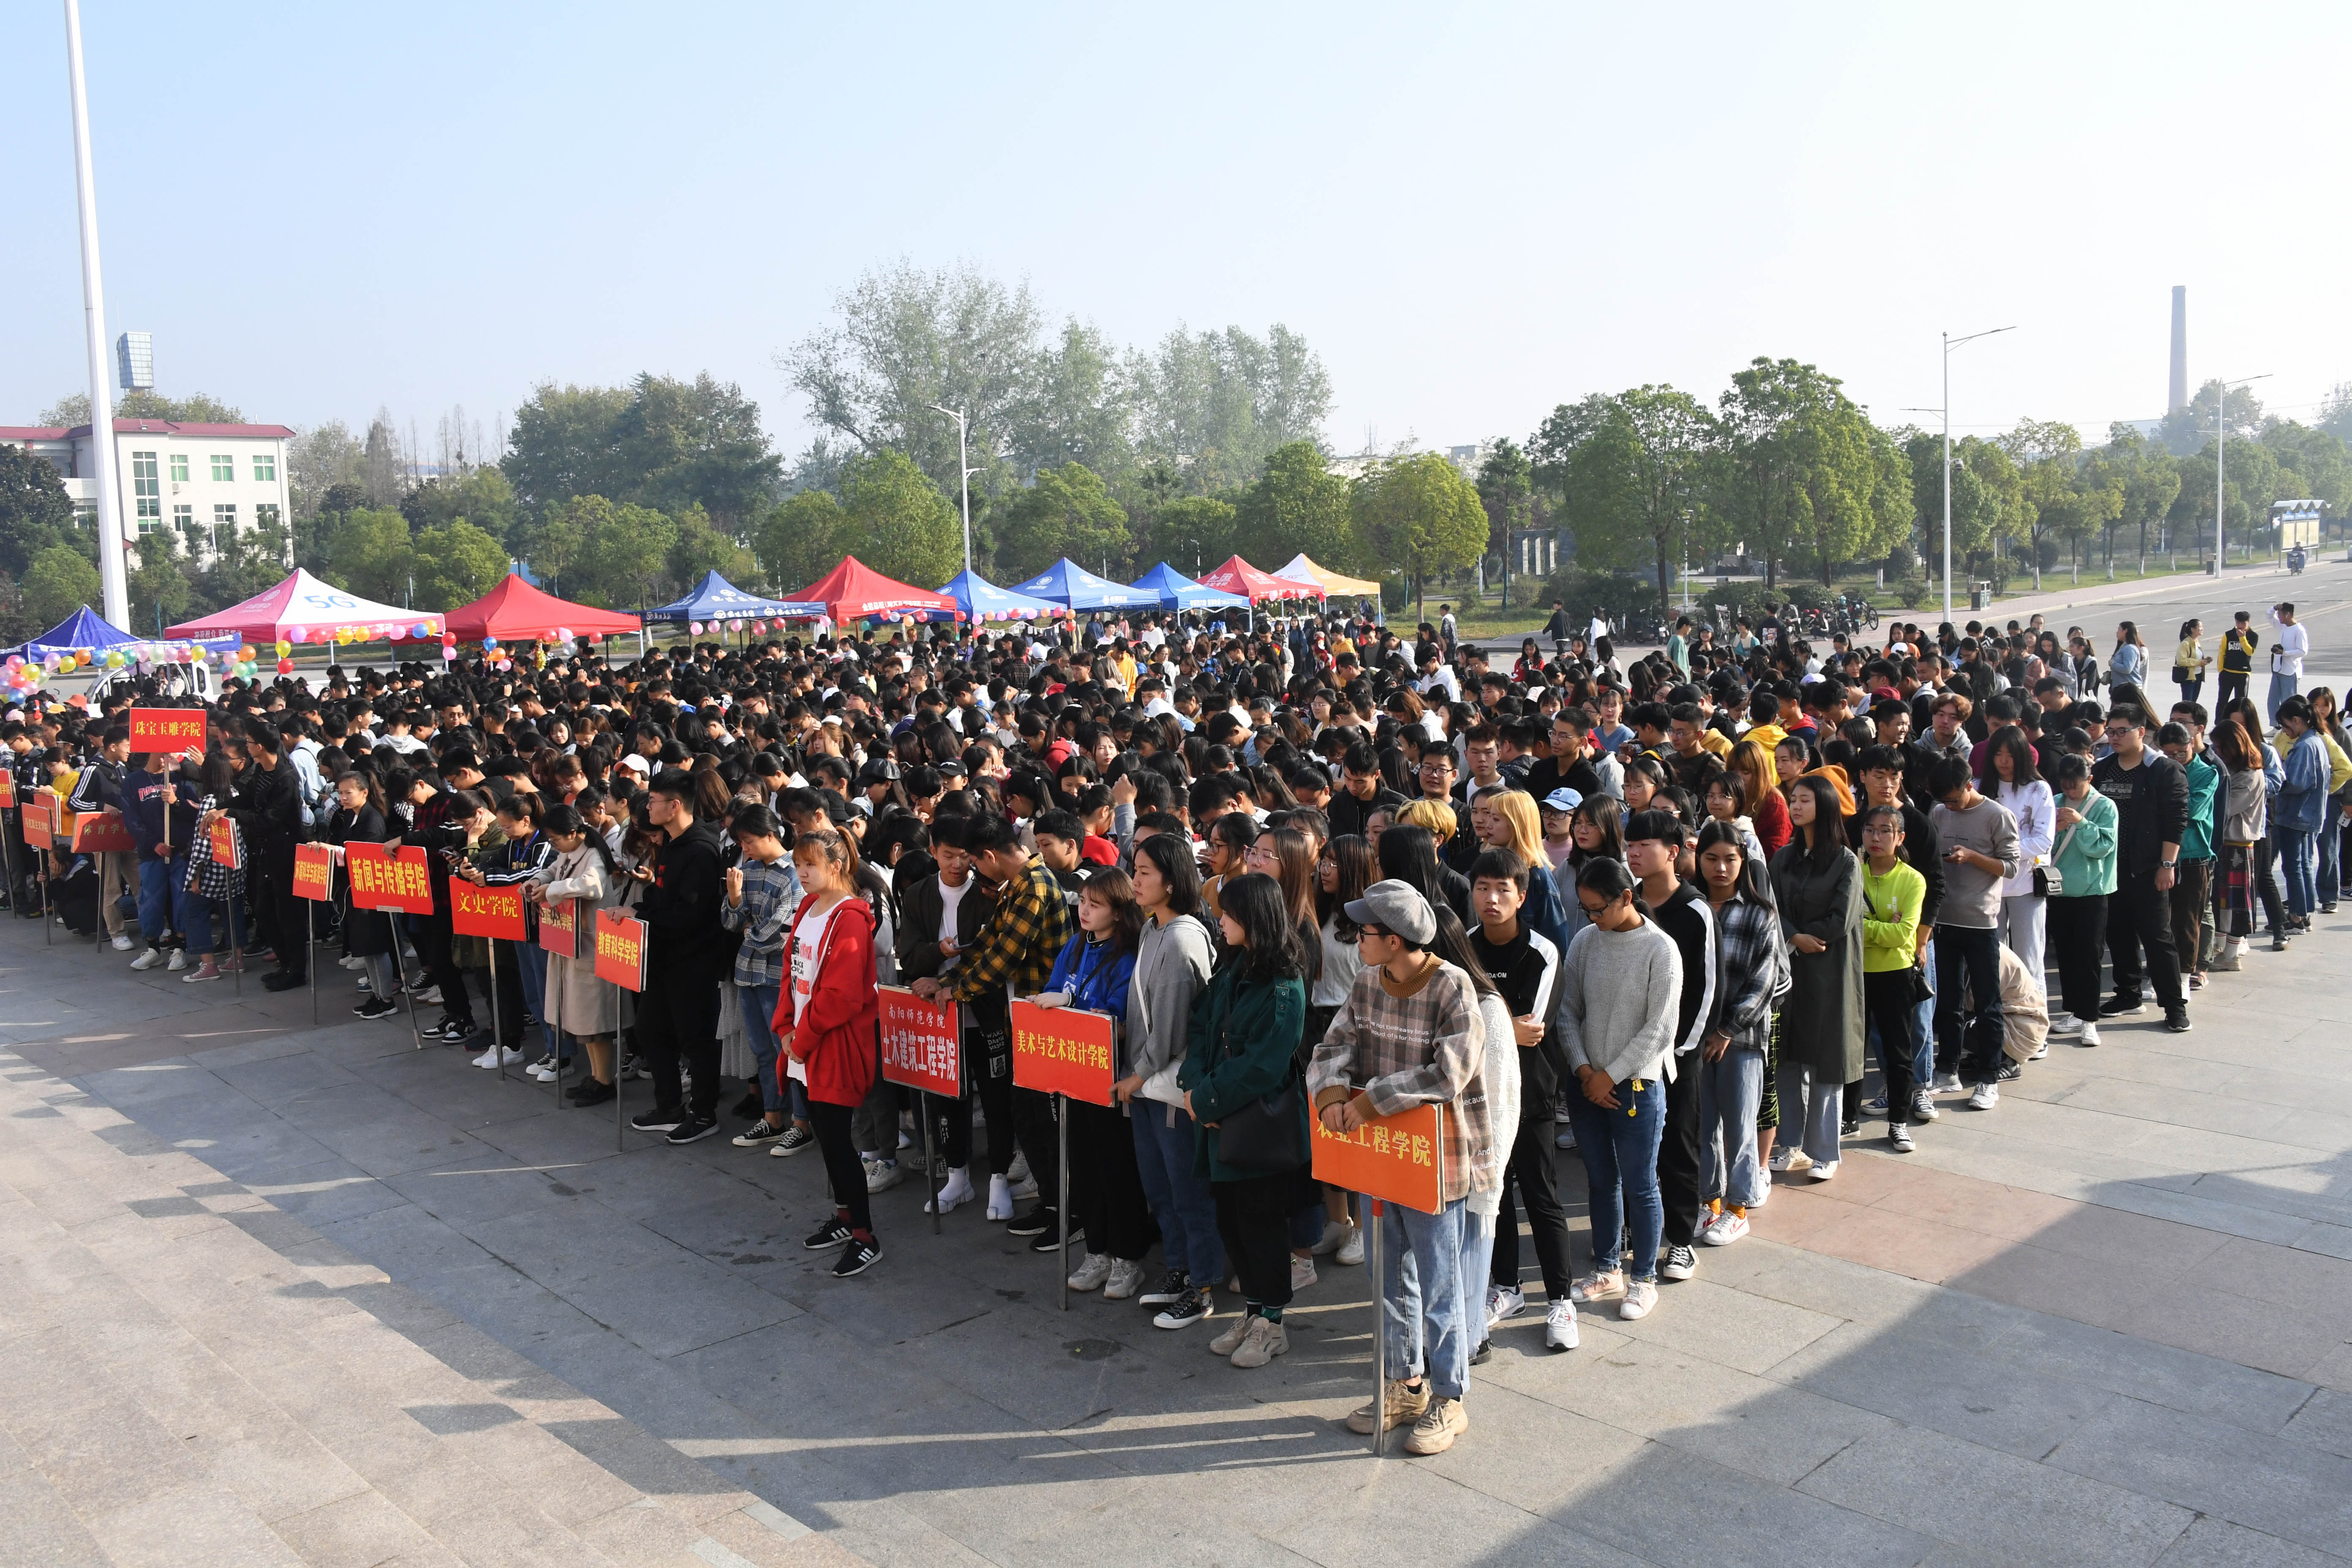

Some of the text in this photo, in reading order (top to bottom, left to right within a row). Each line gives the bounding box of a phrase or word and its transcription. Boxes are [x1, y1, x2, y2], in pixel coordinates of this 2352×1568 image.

[303, 595, 357, 609] 5G
[135, 721, 201, 737] 珠宝玉雕学院
[0, 783, 11, 795] 学院
[24, 817, 49, 833] 马克思主义学院
[215, 842, 230, 858] 工程学院
[295, 860, 327, 886] 环境科学与旅游学院
[351, 857, 428, 898] 新闻与传播学院
[456, 892, 518, 918] 文史学院
[598, 929, 638, 967] 教育科学学院
[888, 1003, 945, 1029] 南阳师范学院
[883, 1024, 956, 1081] 土木建筑工程学院
[989, 1041, 1004, 1051] VADER
[1017, 1029, 1109, 1070] 美术与艺术设计学院
[1477, 1146, 1490, 1157] And
